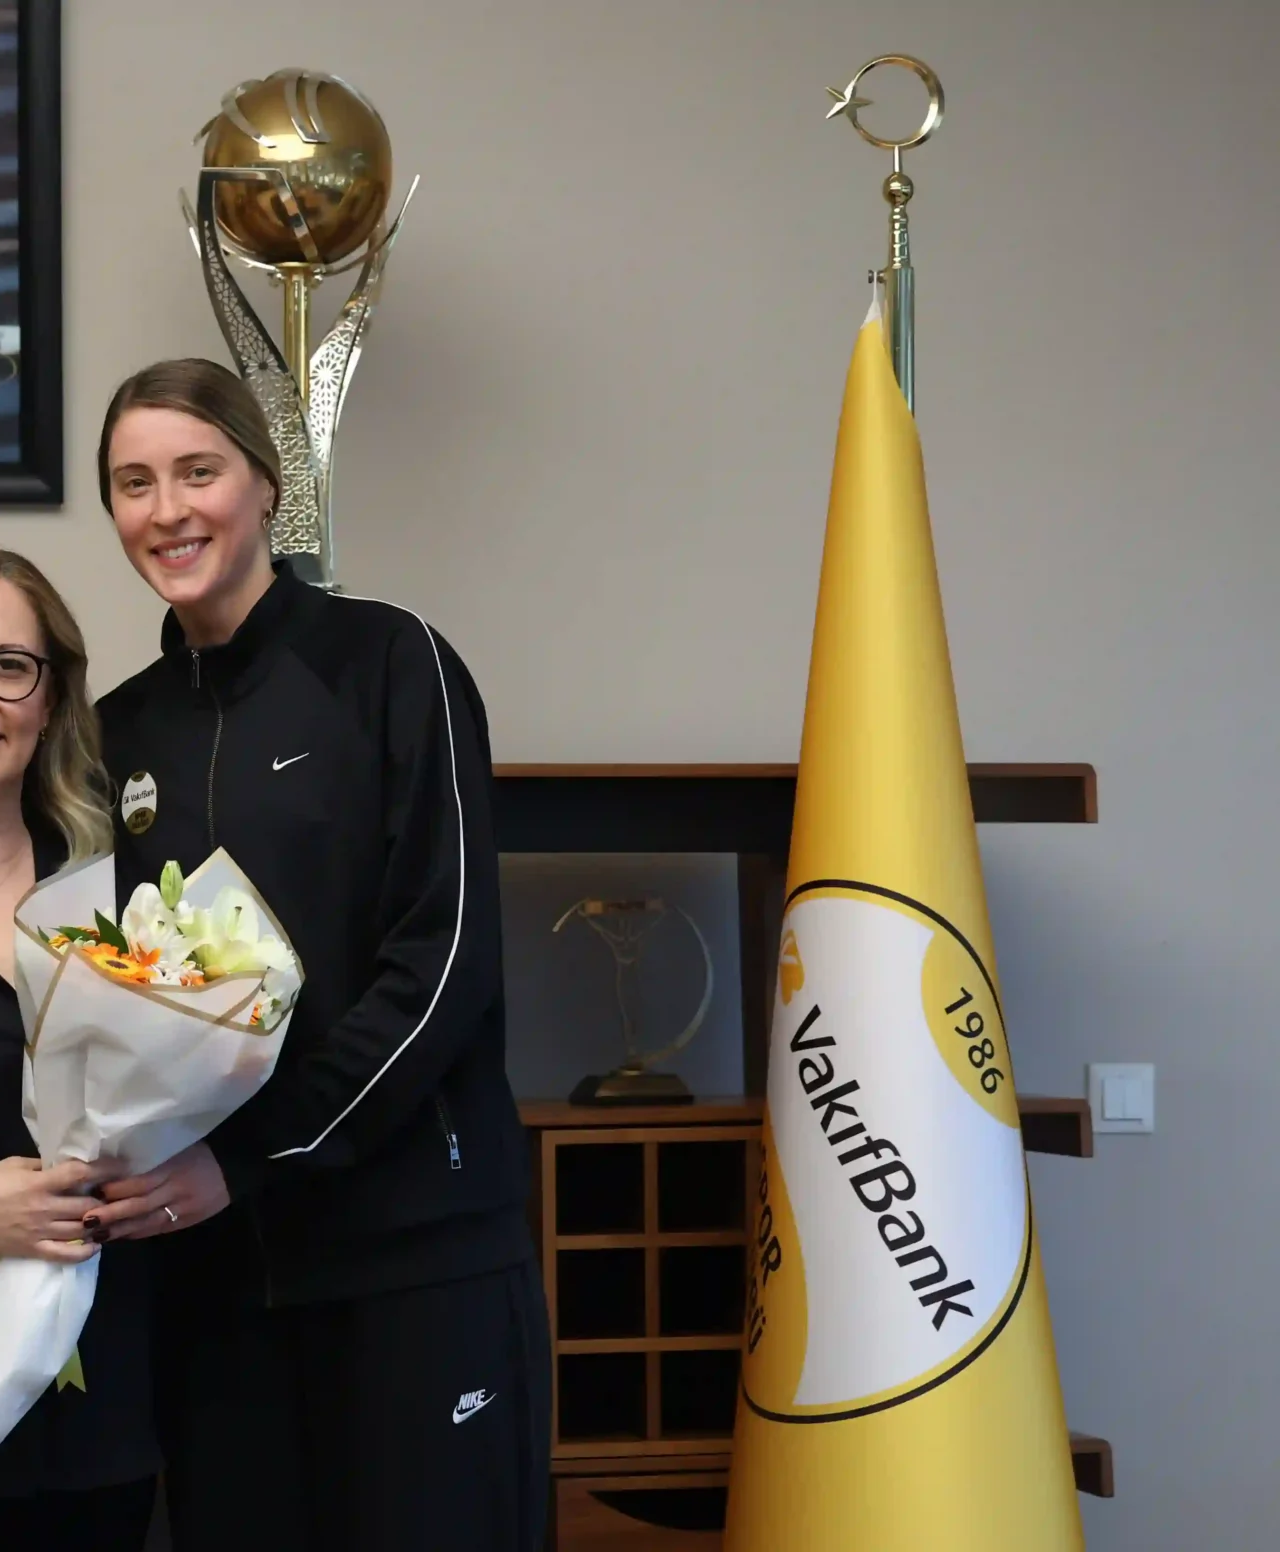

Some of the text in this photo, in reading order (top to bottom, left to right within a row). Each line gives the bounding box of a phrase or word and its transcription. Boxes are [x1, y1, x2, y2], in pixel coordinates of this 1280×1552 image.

[944, 987, 1005, 1095] 1986
[789, 1004, 975, 1332] VakıfBank
[457, 1388, 486, 1411] NIKE
